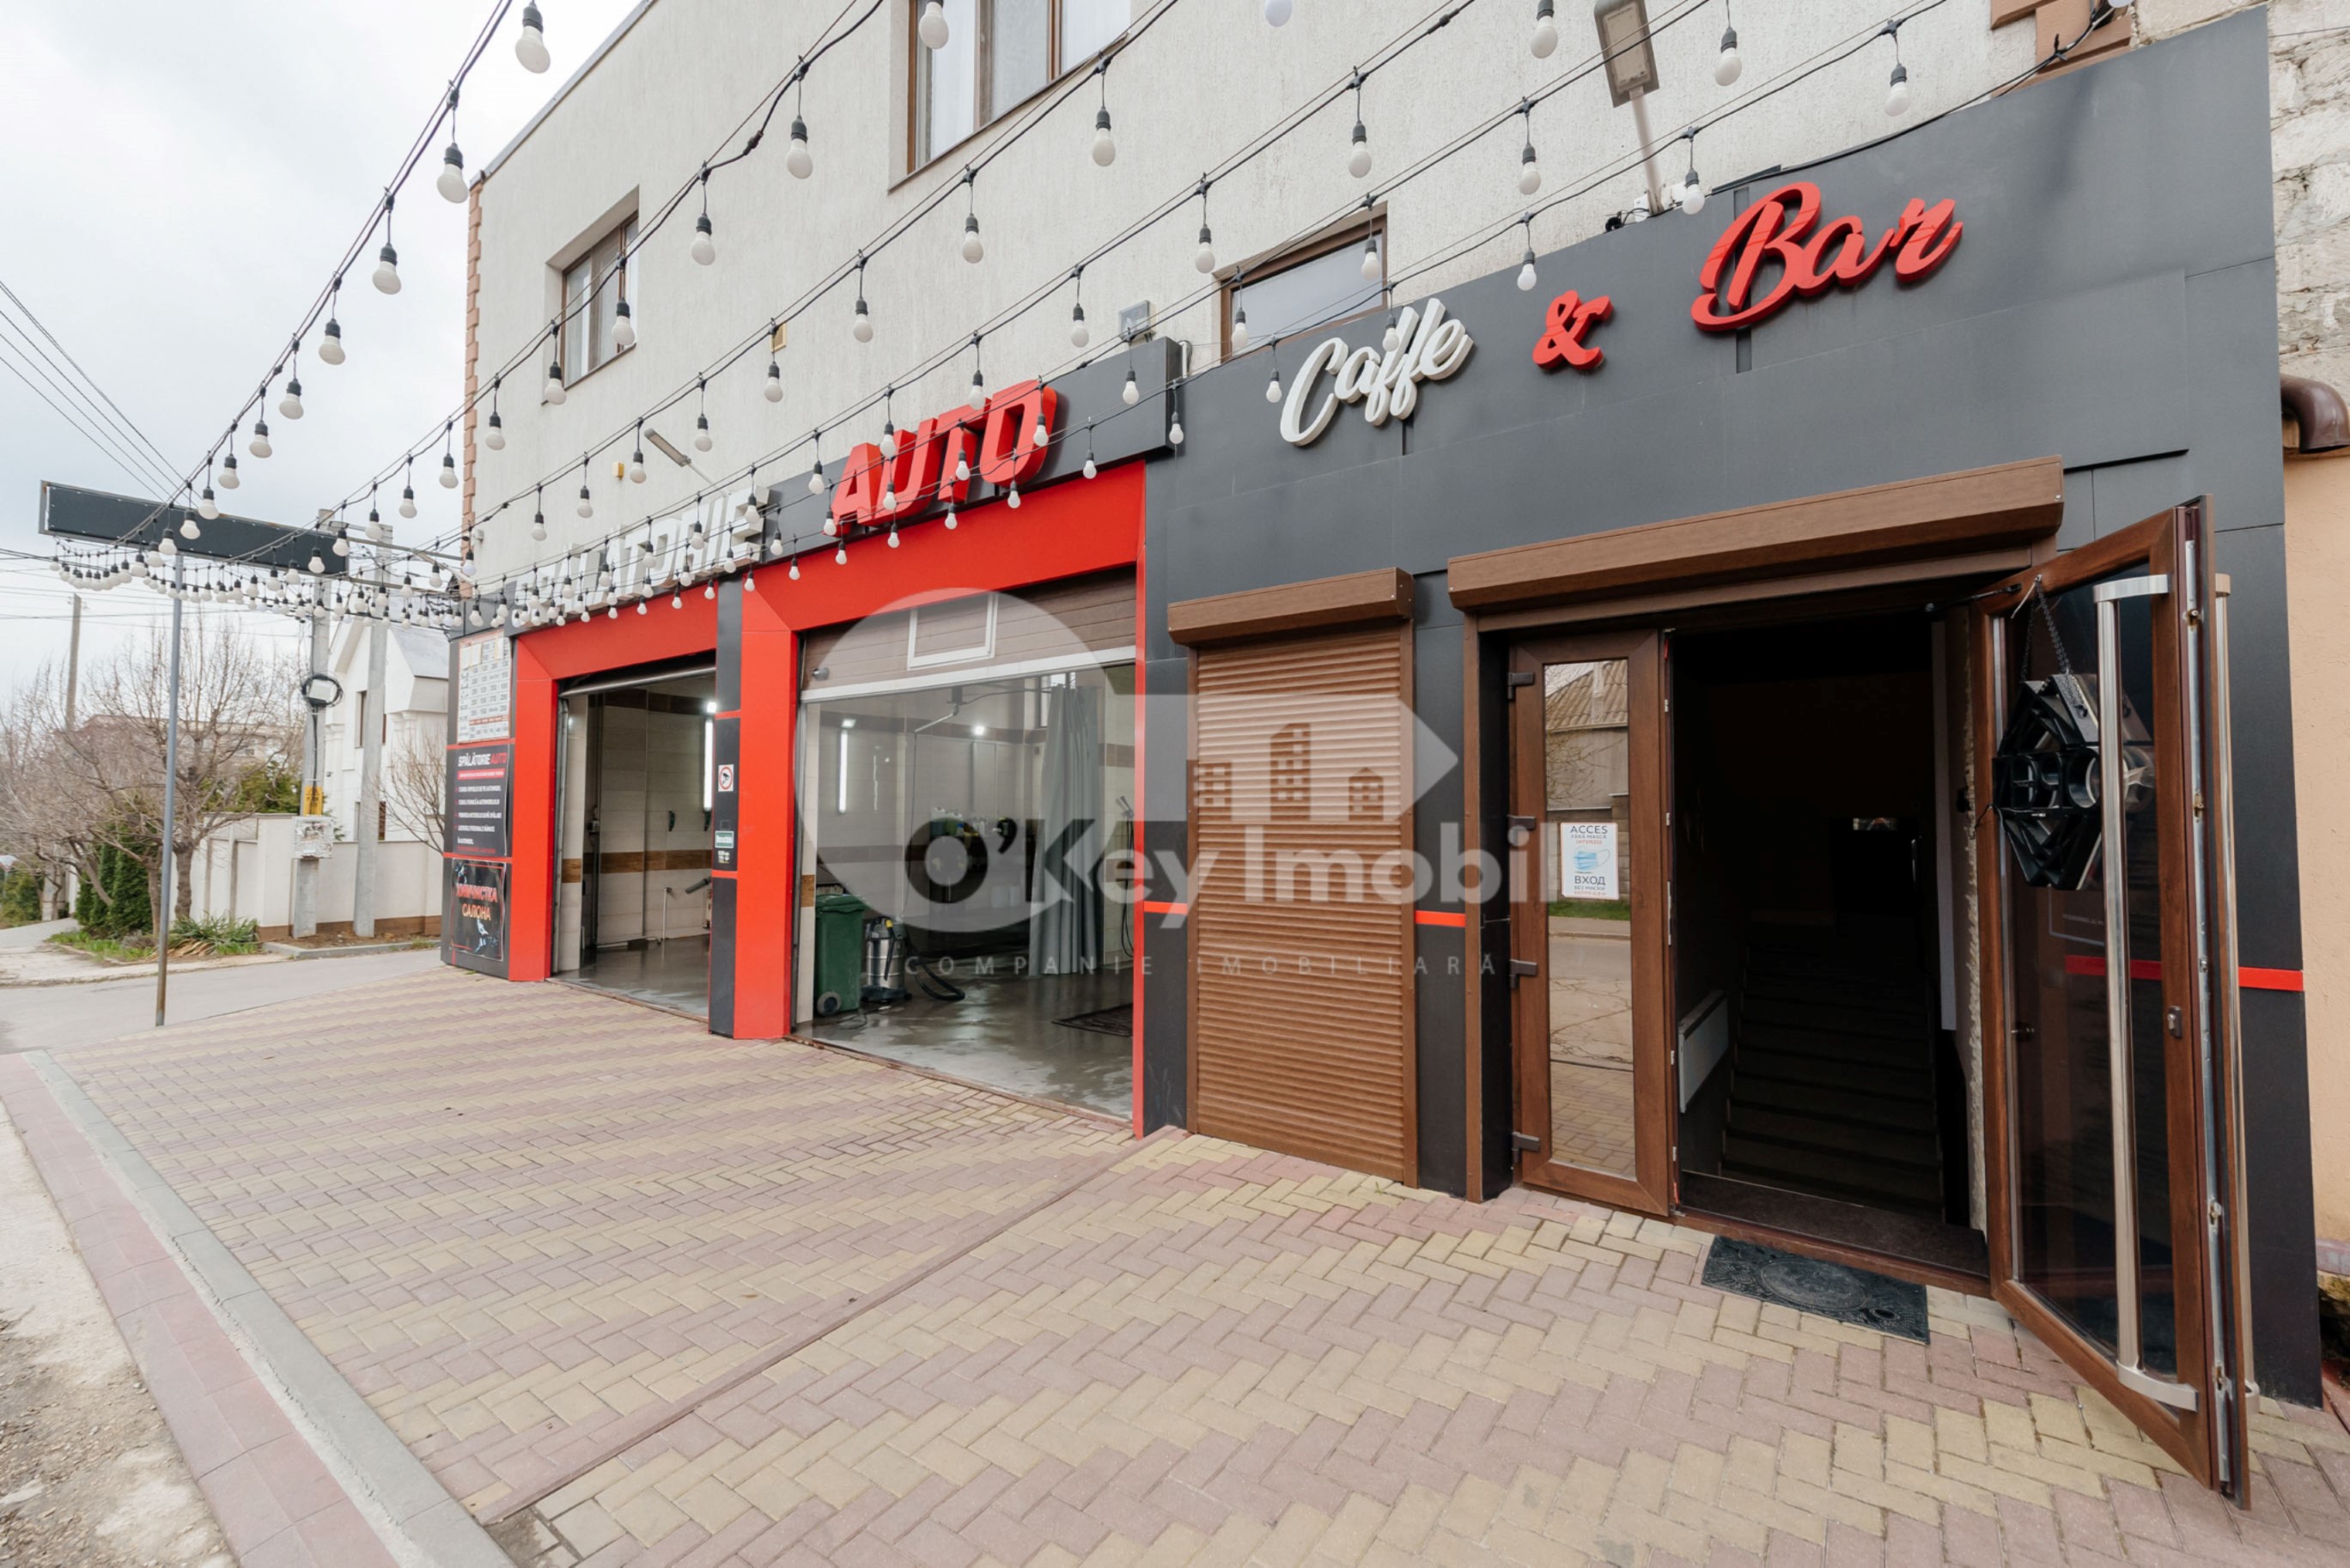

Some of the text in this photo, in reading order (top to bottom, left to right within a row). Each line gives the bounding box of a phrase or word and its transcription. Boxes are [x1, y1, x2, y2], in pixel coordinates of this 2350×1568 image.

[1280, 181, 1964, 447] Caffe & Bar
[823, 380, 1057, 538] AUTO
[490, 752, 508, 764] AUTO
[1570, 825, 1608, 834] ACCES
[1574, 876, 1606, 886] ВХОД
[461, 903, 492, 921] САЛОНА
